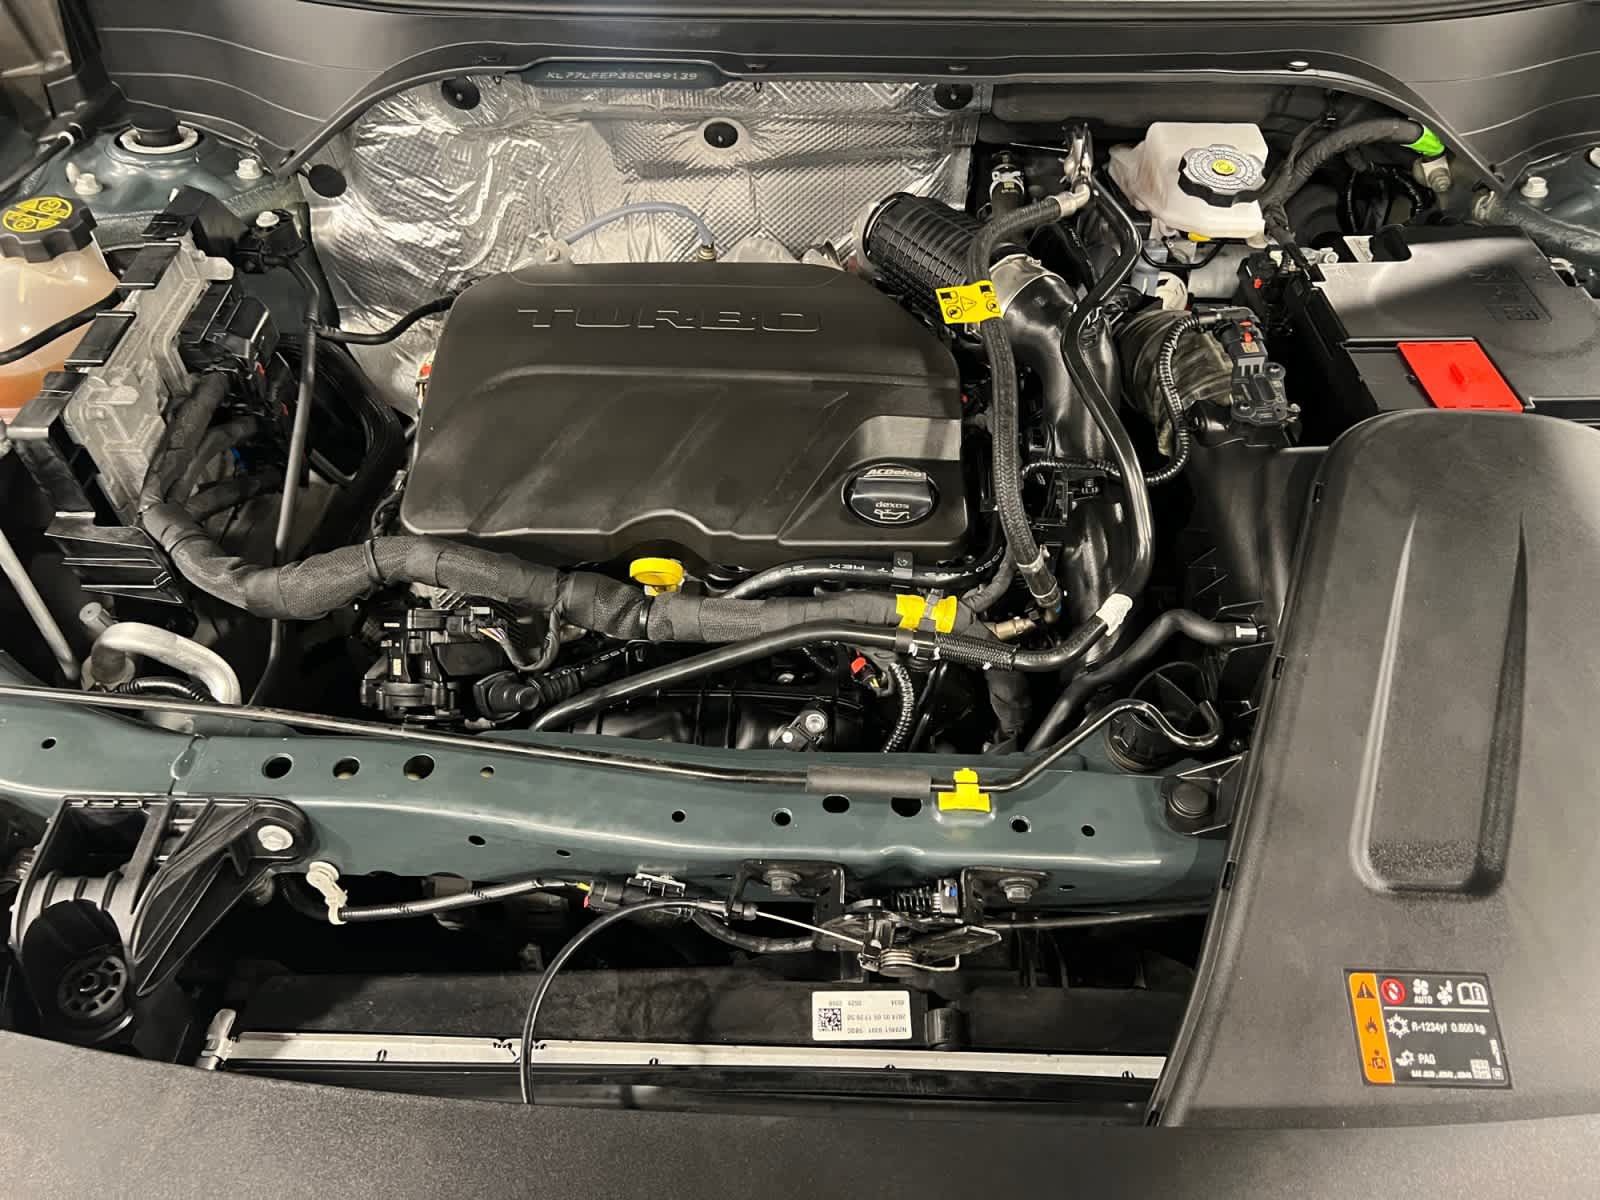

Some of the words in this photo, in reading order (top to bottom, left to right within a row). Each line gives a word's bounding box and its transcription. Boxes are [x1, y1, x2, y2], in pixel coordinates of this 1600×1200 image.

[517, 306, 822, 332] TURBO
[875, 500, 910, 509] dexos
[1413, 995, 1433, 1004] AUTO
